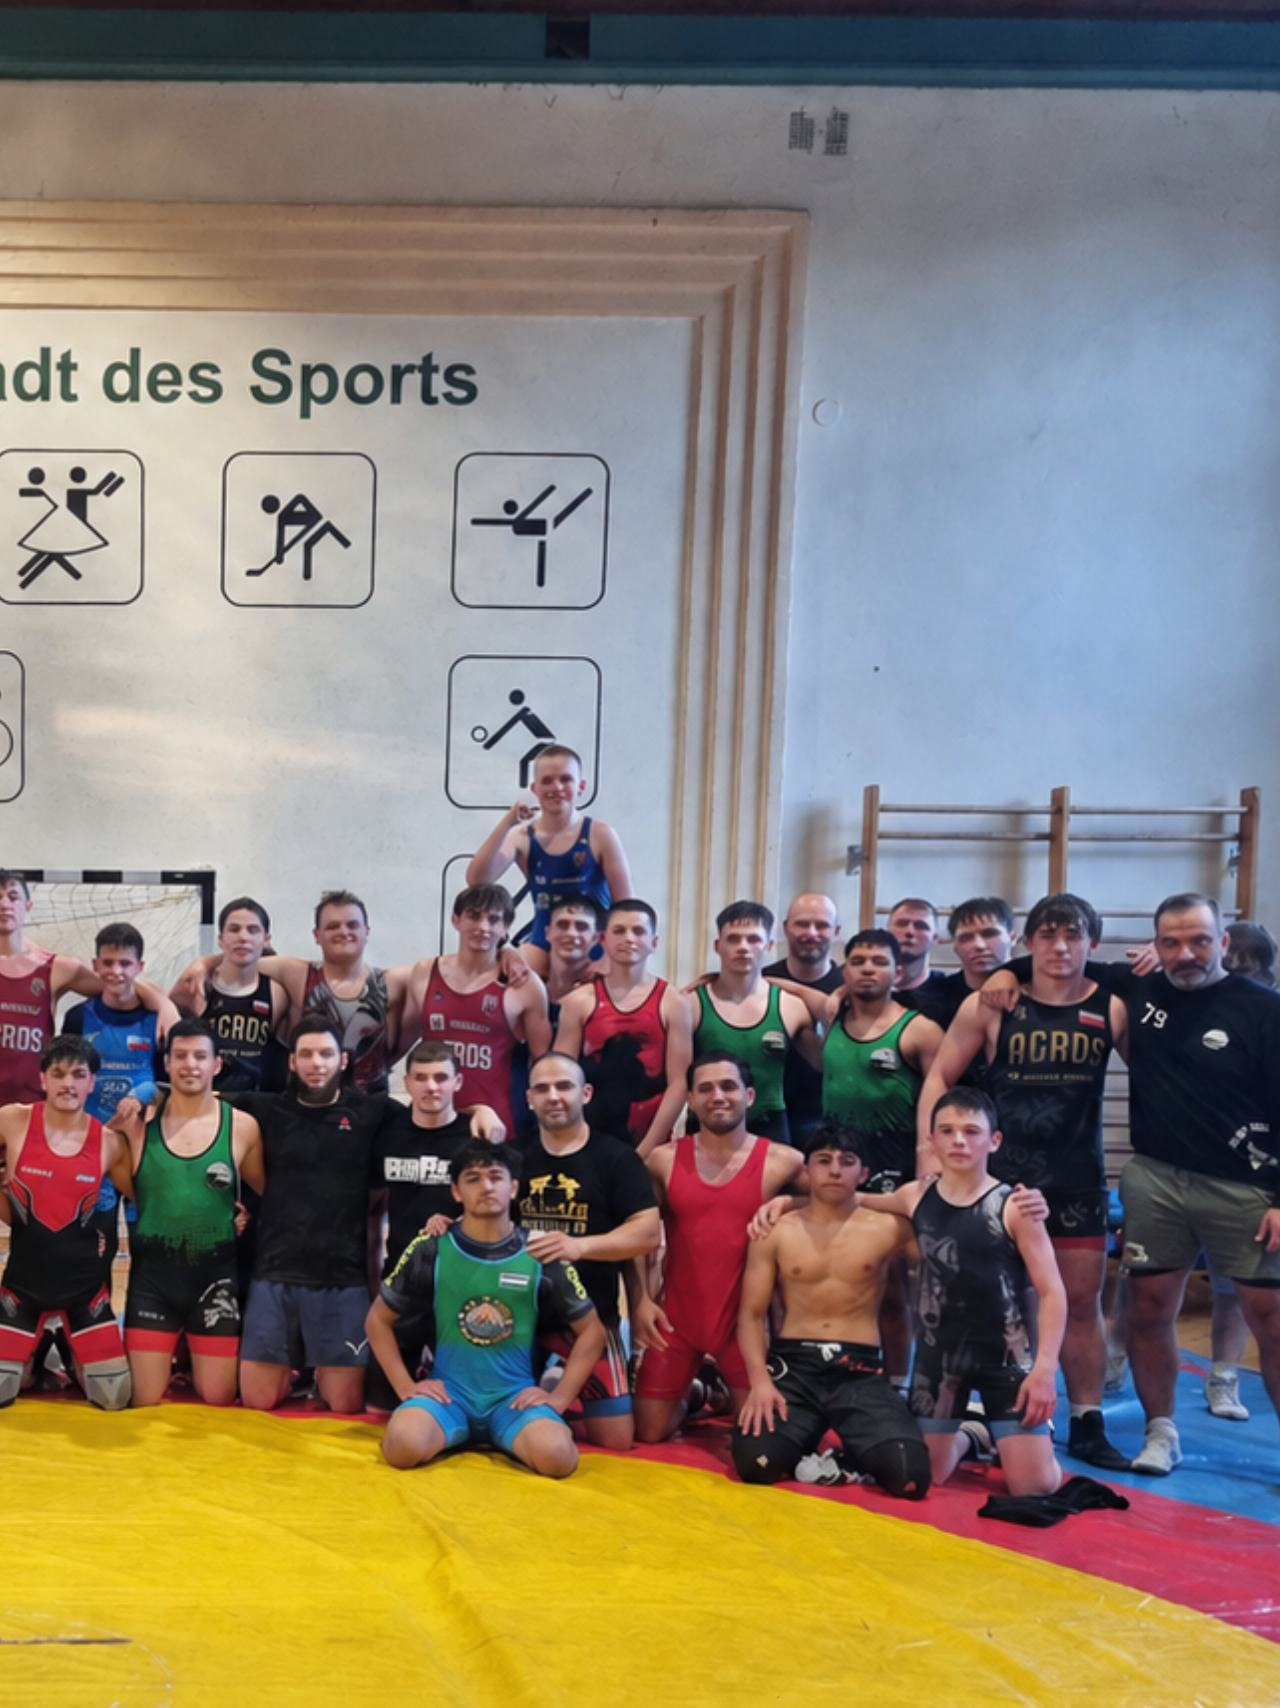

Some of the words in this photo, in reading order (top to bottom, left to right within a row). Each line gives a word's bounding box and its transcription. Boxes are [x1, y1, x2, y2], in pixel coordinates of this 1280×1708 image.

[102, 348, 223, 403] des
[250, 348, 478, 419] Sports
[1140, 1002, 1168, 1029] 79
